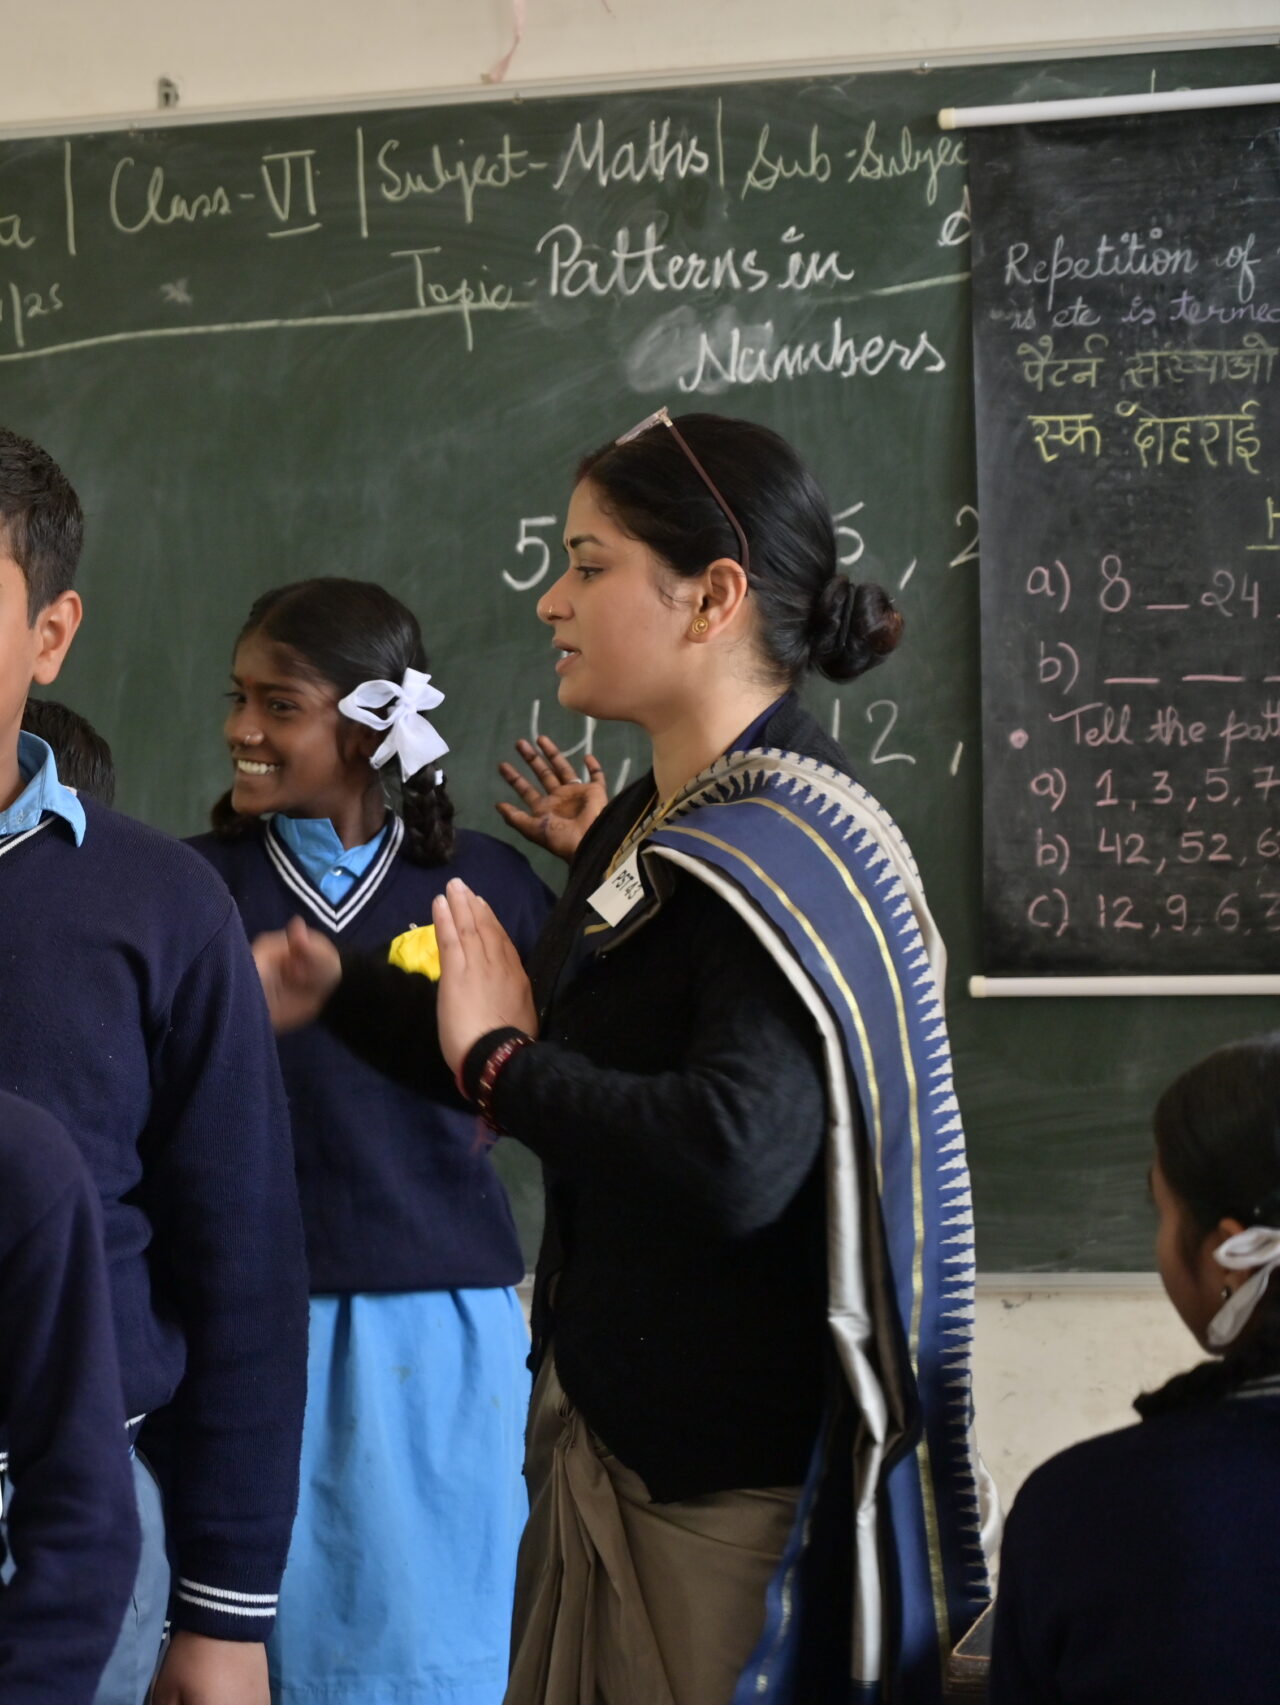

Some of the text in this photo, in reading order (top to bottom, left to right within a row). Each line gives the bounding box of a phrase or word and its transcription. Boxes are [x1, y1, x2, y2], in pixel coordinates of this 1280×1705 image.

[1004, 227, 1261, 311] Repetition of
[1052, 296, 1101, 328] etc
[679, 317, 946, 392] Numbers
[1026, 560, 1071, 613] a)
[1049, 702, 1134, 745] Tell
[1146, 706, 1205, 746] the
[1030, 767, 1067, 812] a)
